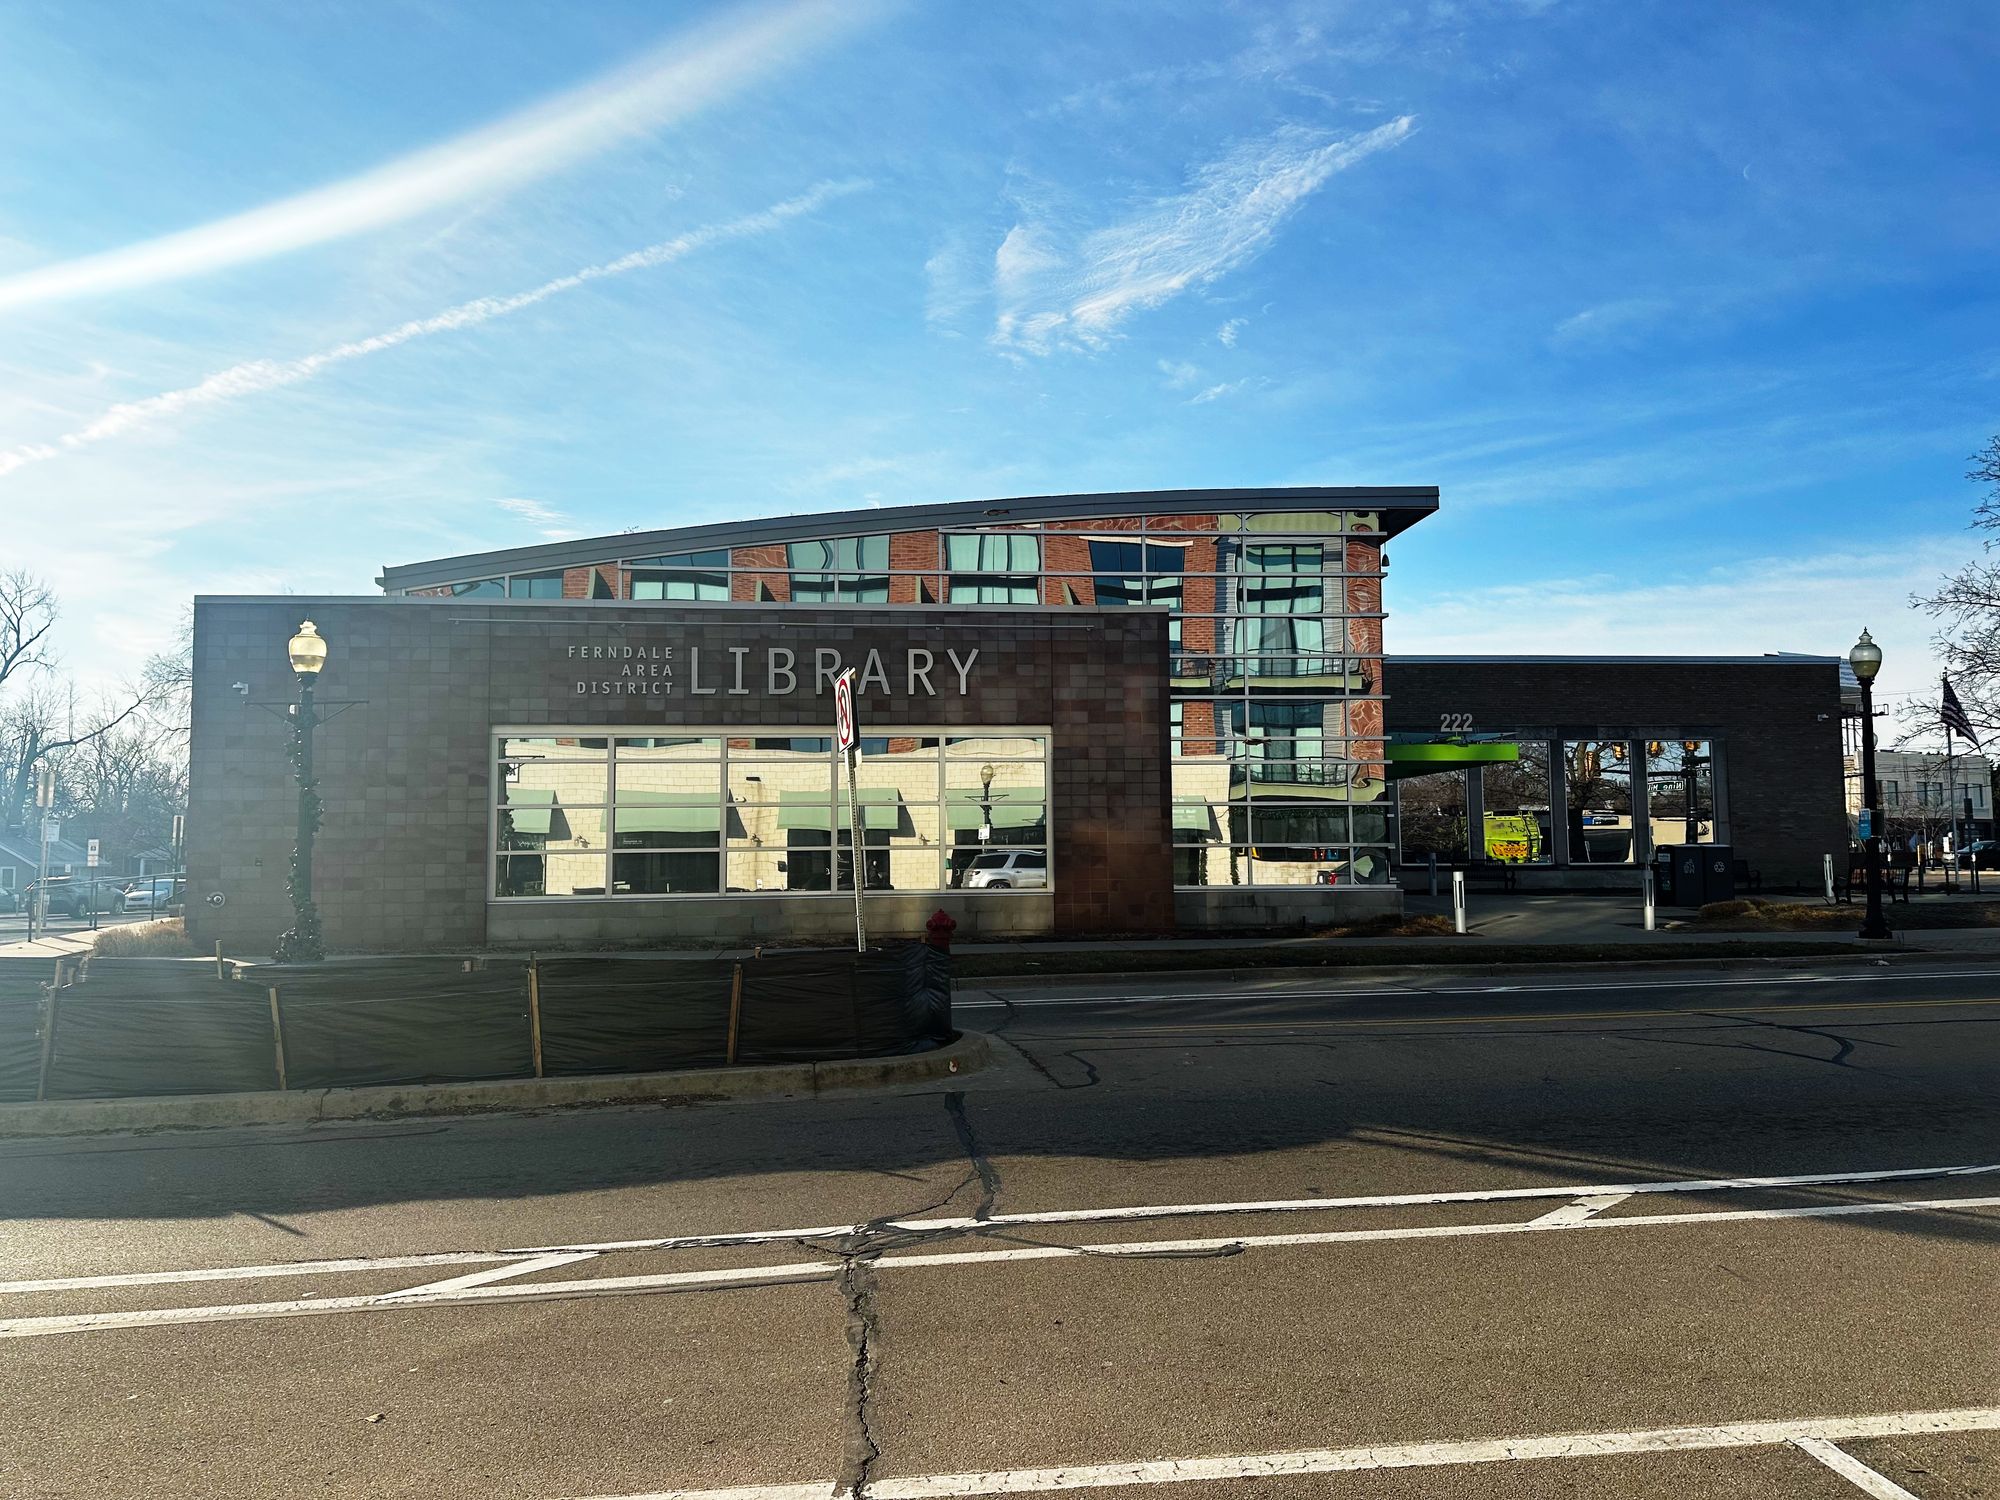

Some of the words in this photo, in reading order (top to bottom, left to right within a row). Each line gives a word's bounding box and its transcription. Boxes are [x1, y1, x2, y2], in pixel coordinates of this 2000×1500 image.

[568, 645, 673, 659] FERNDALE
[621, 664, 673, 677] AREA
[691, 646, 979, 696] LIBRARY
[577, 681, 673, 694] DISTRICT
[1440, 713, 1473, 732] 222
